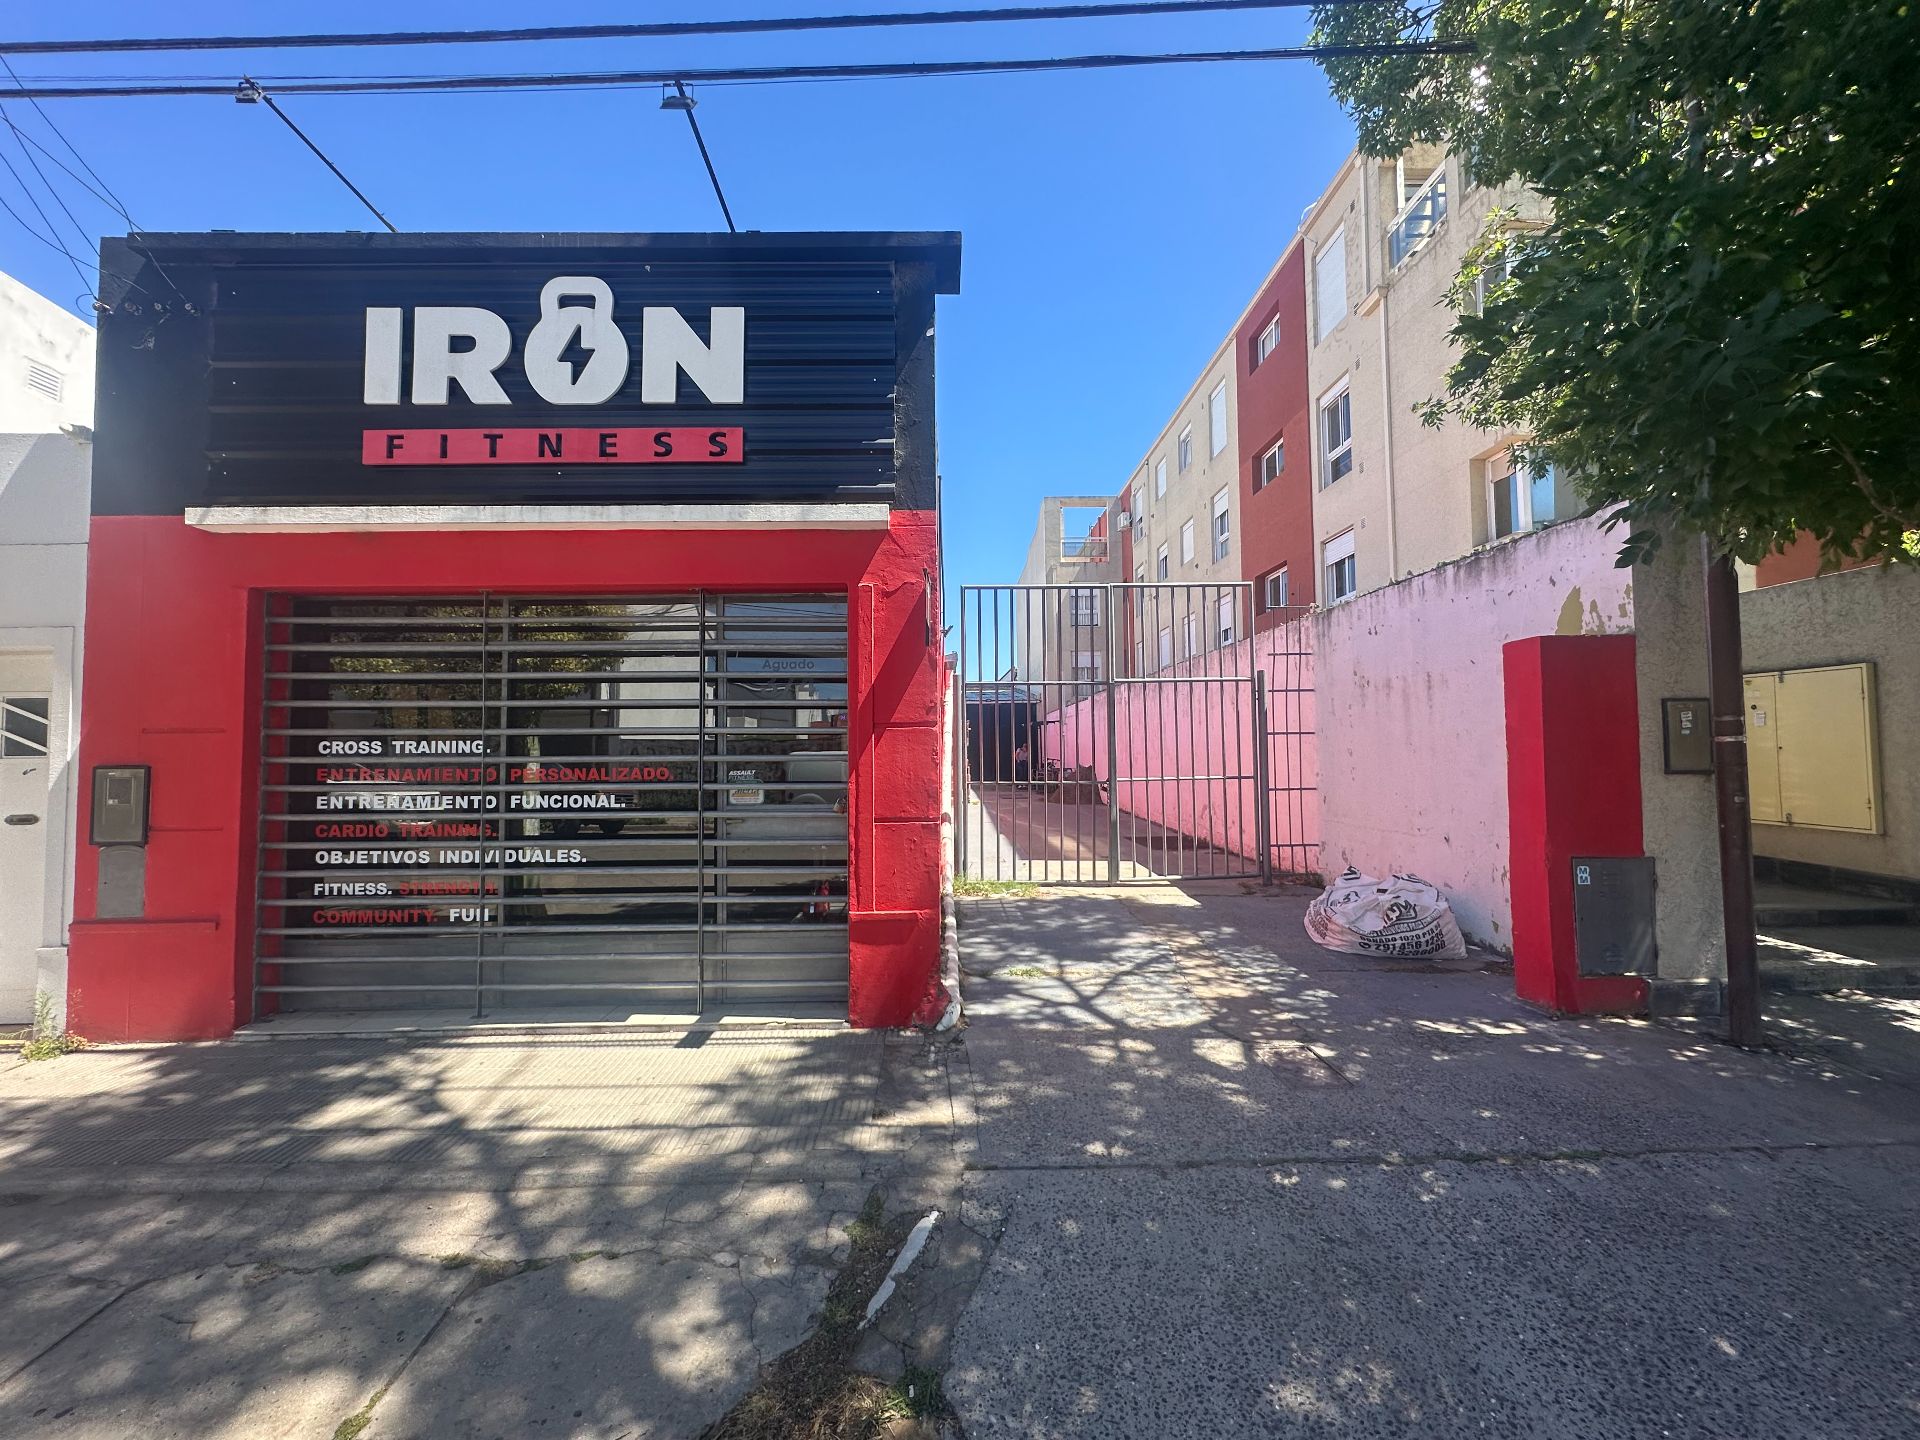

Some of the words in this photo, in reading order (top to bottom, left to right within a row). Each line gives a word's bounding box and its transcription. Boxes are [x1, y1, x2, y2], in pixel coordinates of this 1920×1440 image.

[363, 275, 745, 405] IRON
[385, 432, 729, 459] FITNESS
[762, 659, 815, 672] Aguado
[318, 740, 382, 754] CROSS
[392, 740, 491, 754] TRAINING.
[316, 768, 497, 782] ENTRENAMIENTO
[510, 767, 674, 781] PERSONALIZADO.
[316, 795, 497, 810] ENTRENAMIENTO
[510, 794, 626, 808] FUNCIONAL.
[315, 824, 389, 838] CARDIO
[401, 823, 497, 838] TRAINING.
[315, 850, 431, 864] OBJETIVOS
[439, 849, 587, 863] INDIVIDUALES.
[314, 882, 393, 896] FITNESS.
[313, 908, 438, 924] COMMUNITY.
